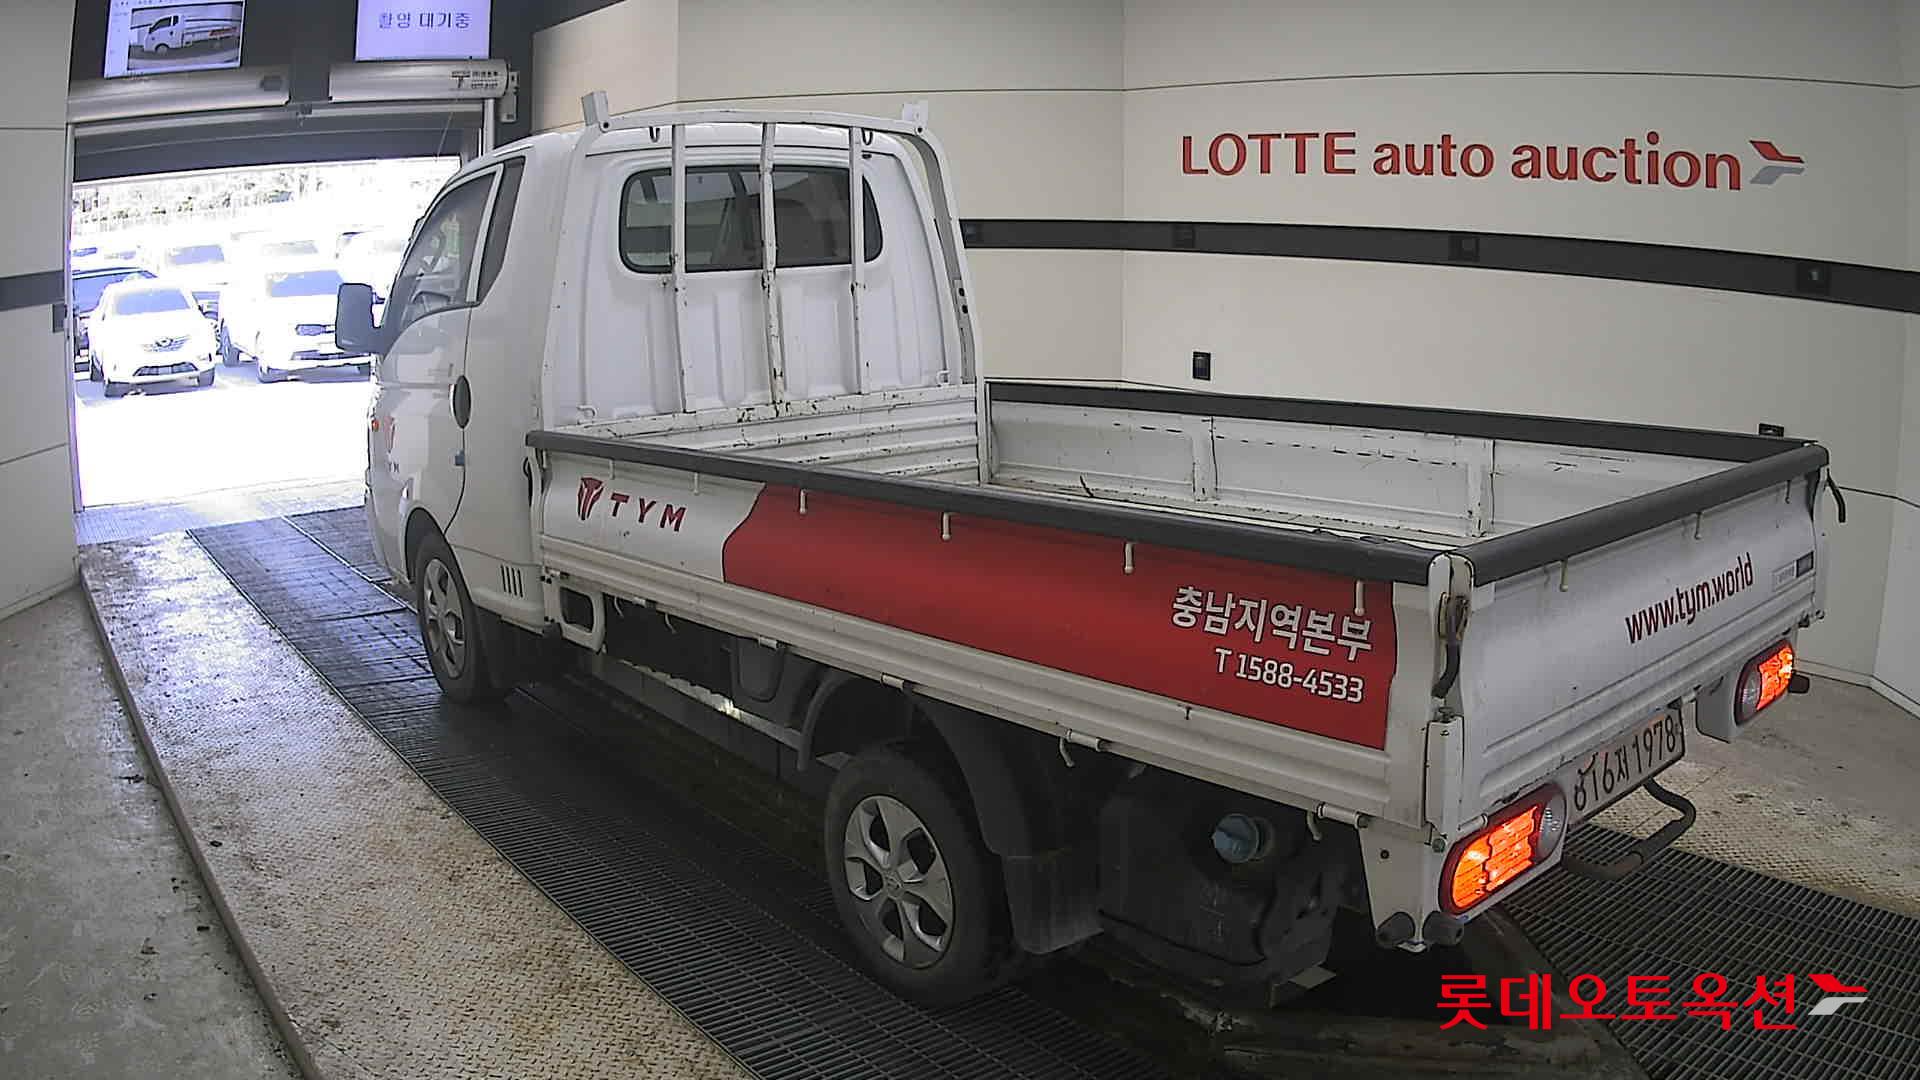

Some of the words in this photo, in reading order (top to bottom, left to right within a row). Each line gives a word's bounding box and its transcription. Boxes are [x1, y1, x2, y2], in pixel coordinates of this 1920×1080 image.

[419, 12, 471, 29] 대기중
[1182, 131, 1356, 176] LOTTE
[1374, 134, 1495, 177] auto
[1512, 132, 1742, 190] auction
[610, 492, 687, 532] TYM
[1172, 586, 1372, 661] 충남지역본부
[1624, 551, 1754, 644] www.tym.world
[1215, 647, 1233, 673] T
[1236, 653, 1364, 703] 1588-4533
